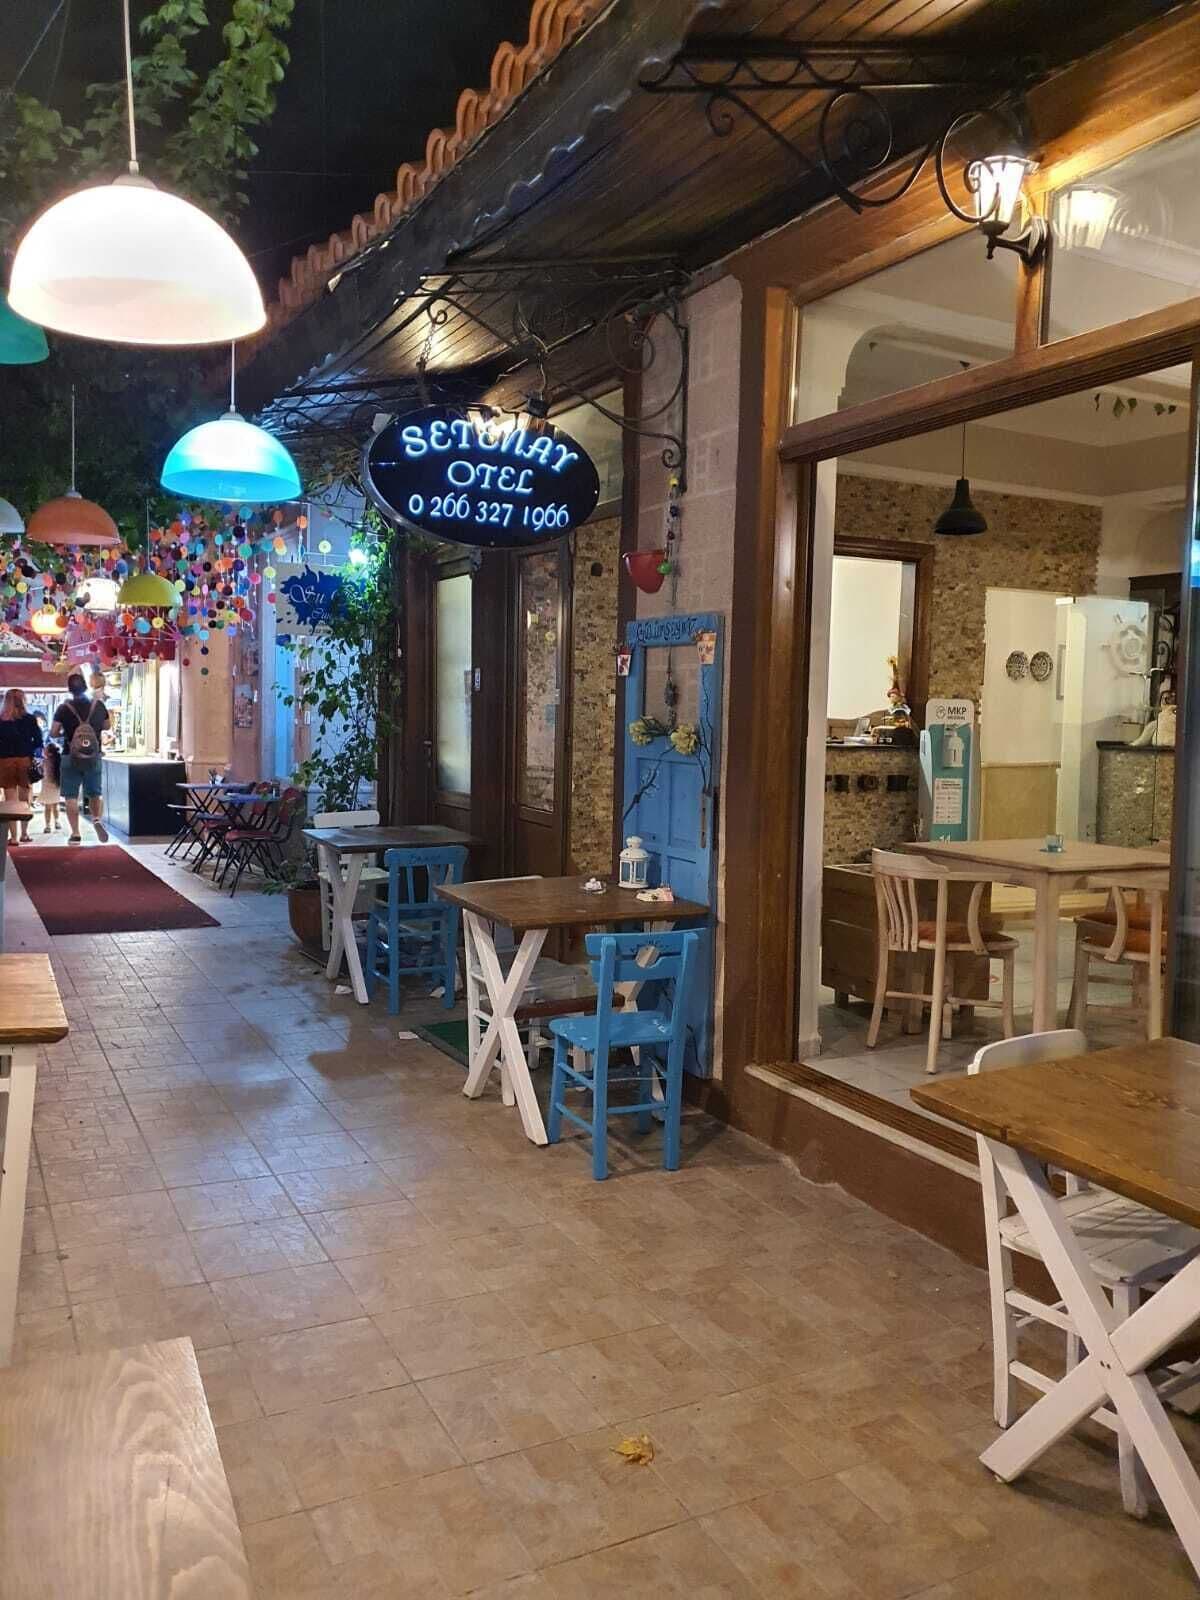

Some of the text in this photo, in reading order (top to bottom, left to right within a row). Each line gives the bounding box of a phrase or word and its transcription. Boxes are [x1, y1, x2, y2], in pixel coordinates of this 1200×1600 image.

[401, 419, 578, 472] SETENAY
[447, 460, 533, 493] OTEL
[408, 492, 569, 531] 0 266 327 1966
[947, 706, 967, 715] MKP
